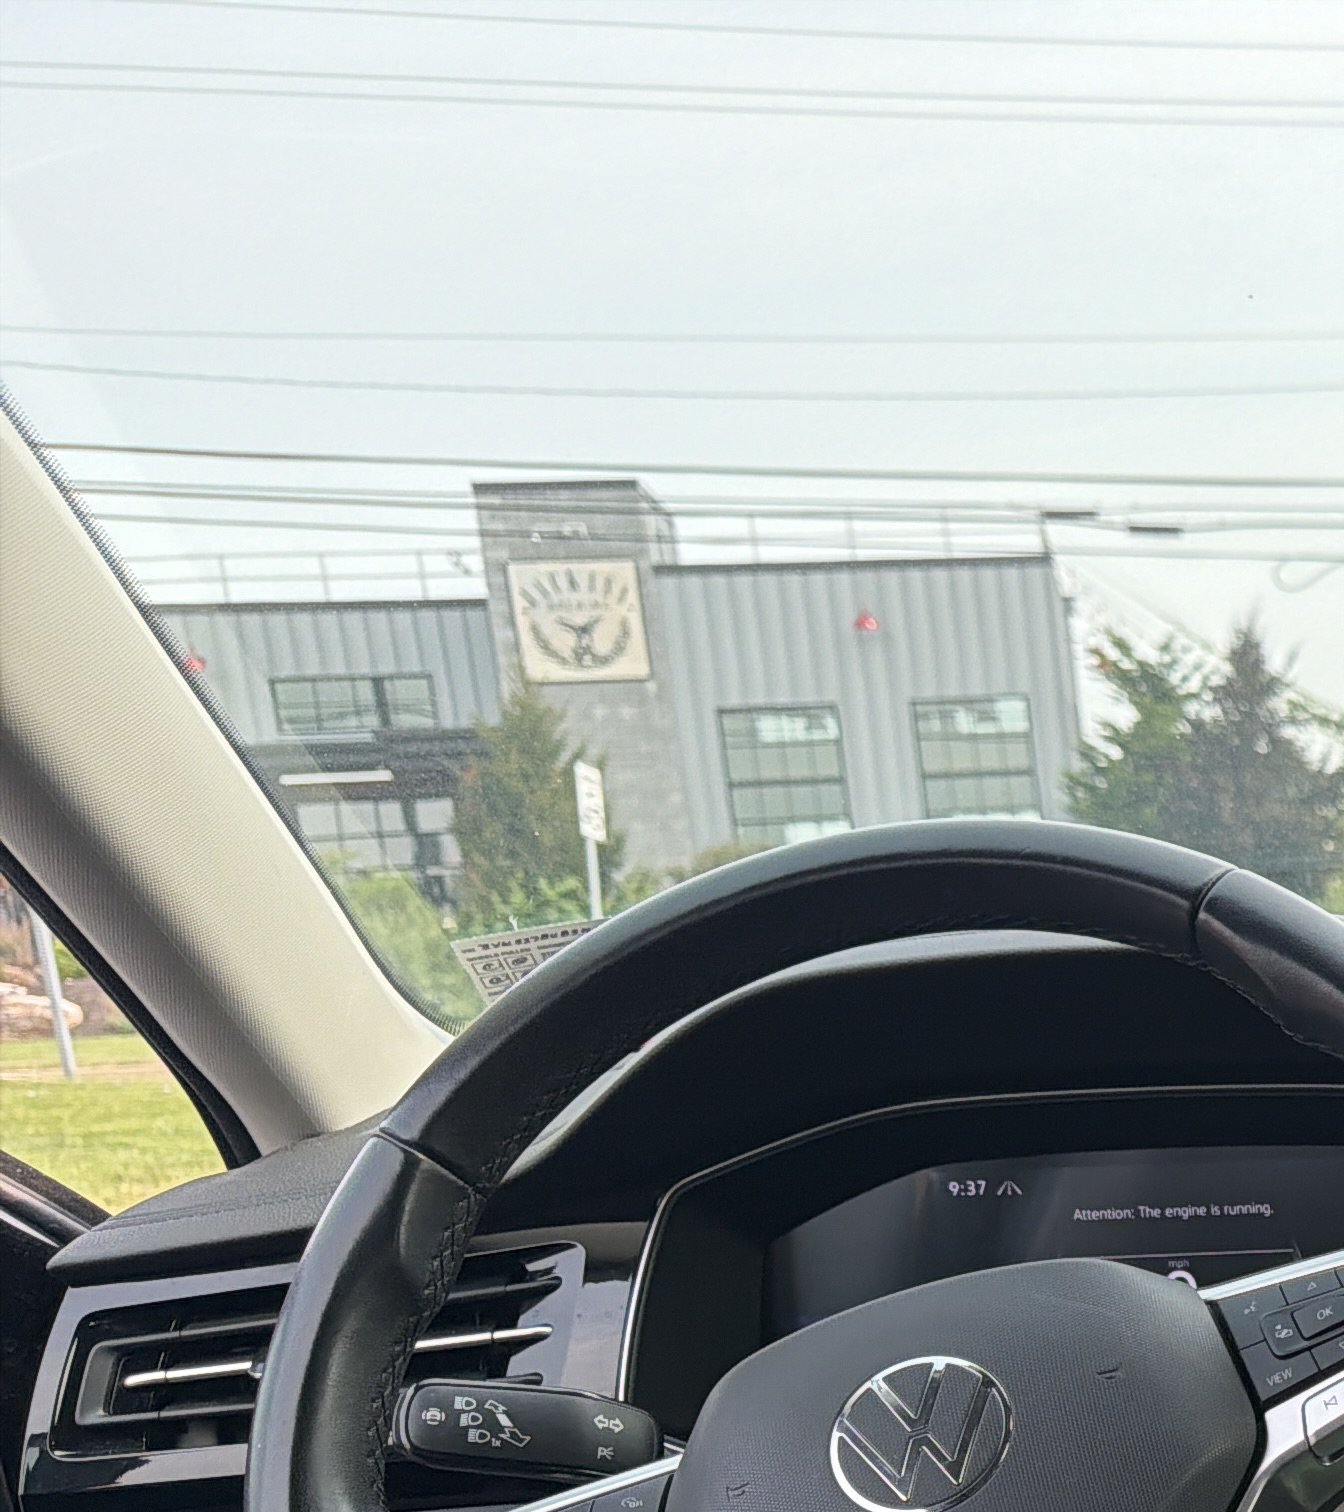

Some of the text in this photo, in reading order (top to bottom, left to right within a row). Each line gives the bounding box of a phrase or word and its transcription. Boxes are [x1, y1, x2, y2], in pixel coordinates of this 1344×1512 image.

[948, 1180, 986, 1197] 9:37
[1073, 1202, 1274, 1221] Attention: The engine is running.
[1168, 1258, 1190, 1269] mph
[1316, 1306, 1334, 1321] OK
[1265, 1367, 1293, 1387] VIEW
